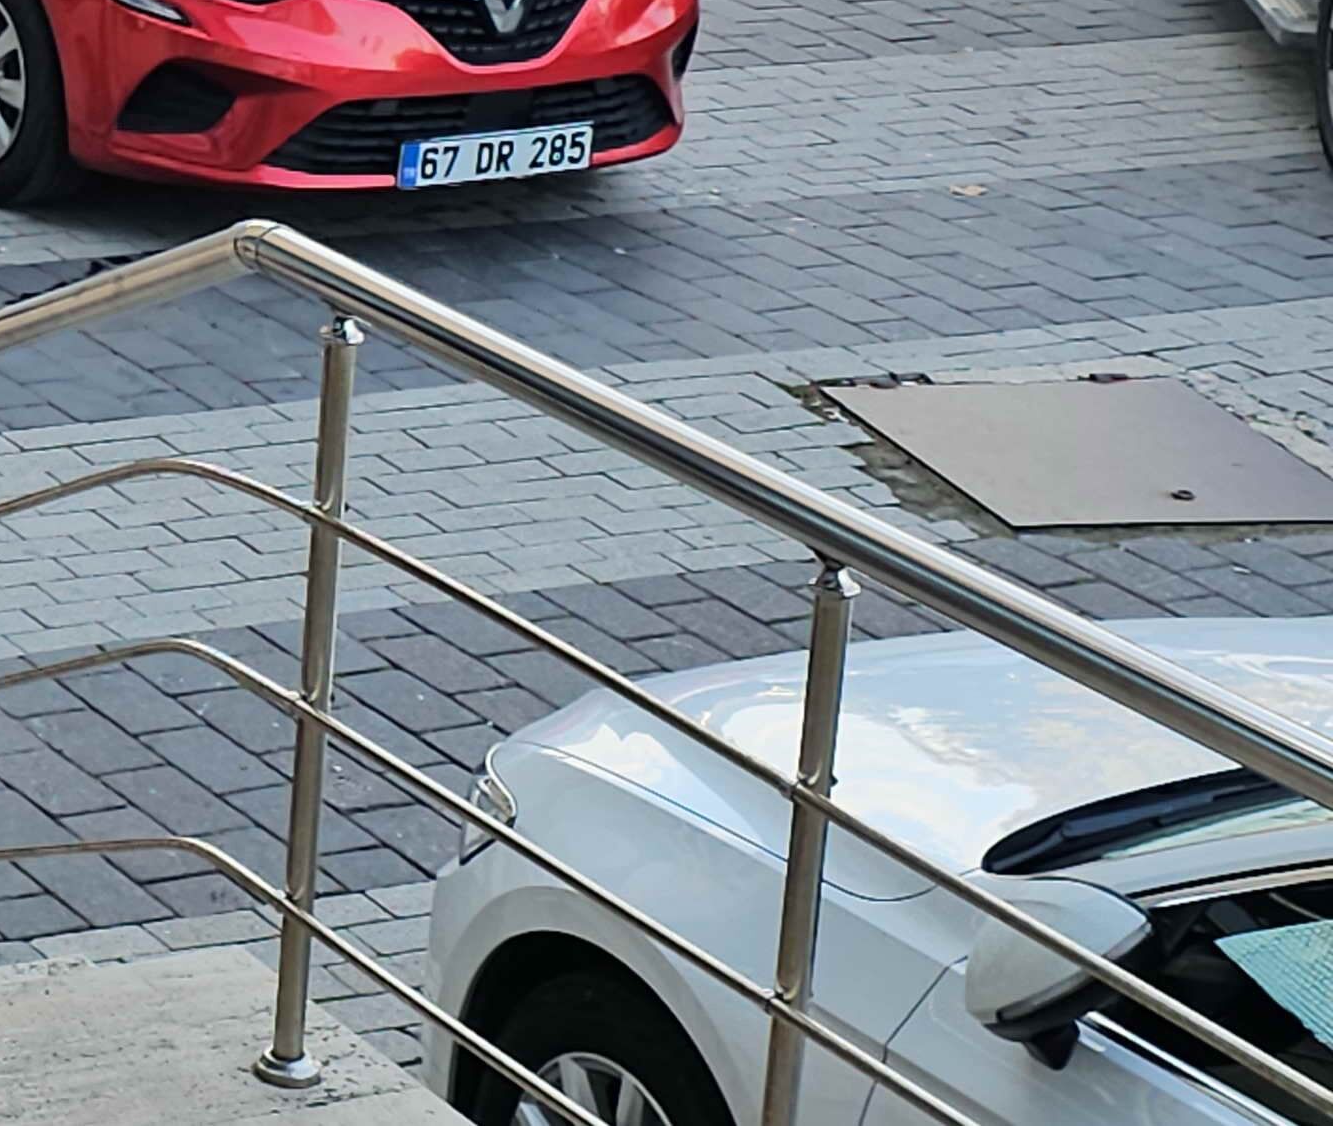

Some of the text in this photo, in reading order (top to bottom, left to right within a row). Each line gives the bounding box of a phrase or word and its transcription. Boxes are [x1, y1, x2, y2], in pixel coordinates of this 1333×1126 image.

[421, 131, 586, 179] 67 DR 285
